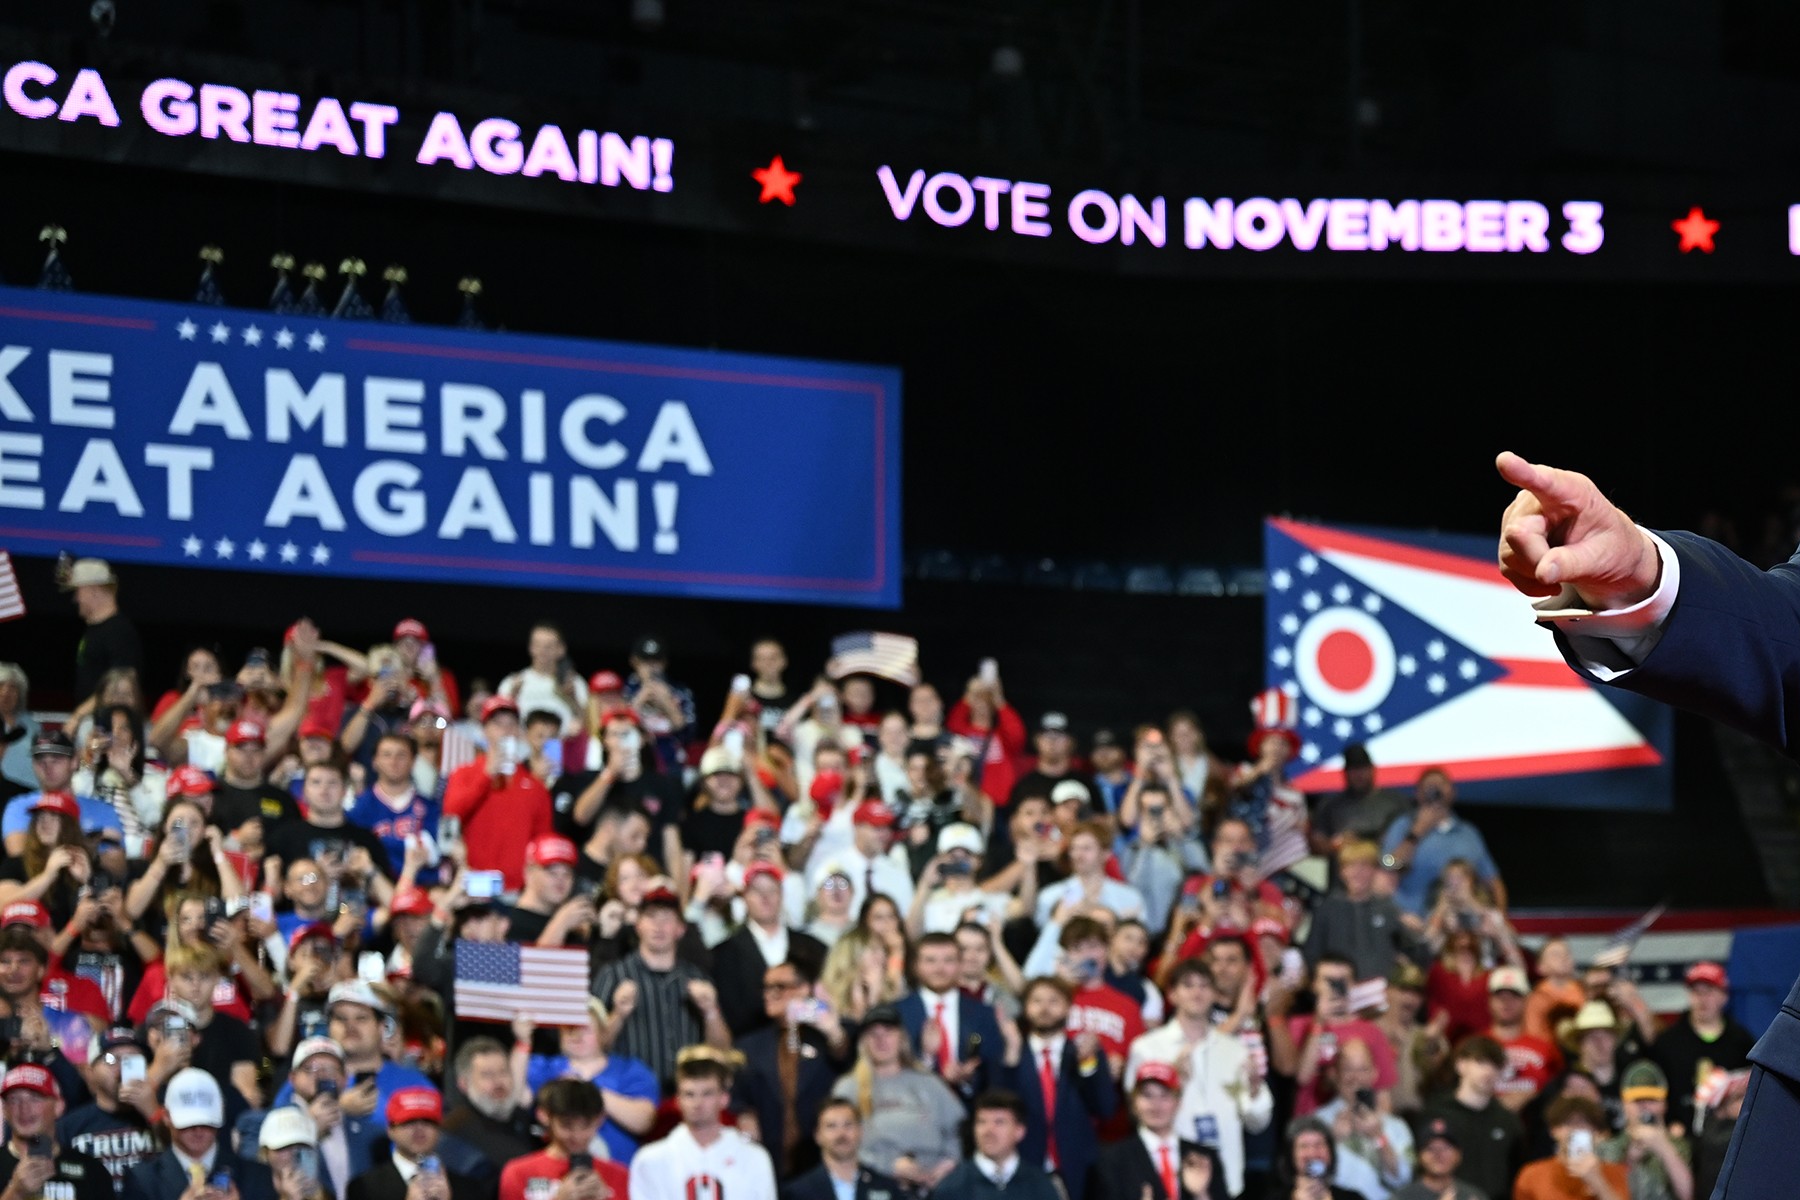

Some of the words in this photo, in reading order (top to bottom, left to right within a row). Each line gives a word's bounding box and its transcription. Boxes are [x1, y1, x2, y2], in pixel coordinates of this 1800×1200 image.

[140, 78, 400, 159] GREAT
[415, 110, 675, 193] AGAIN!
[876, 164, 1052, 238] VOTE
[1067, 188, 1167, 249] ON
[1183, 197, 1551, 254] NOVEMBER
[1561, 200, 1606, 255] 3
[168, 361, 715, 477] AMERICA
[264, 453, 680, 555] AGAIN!
